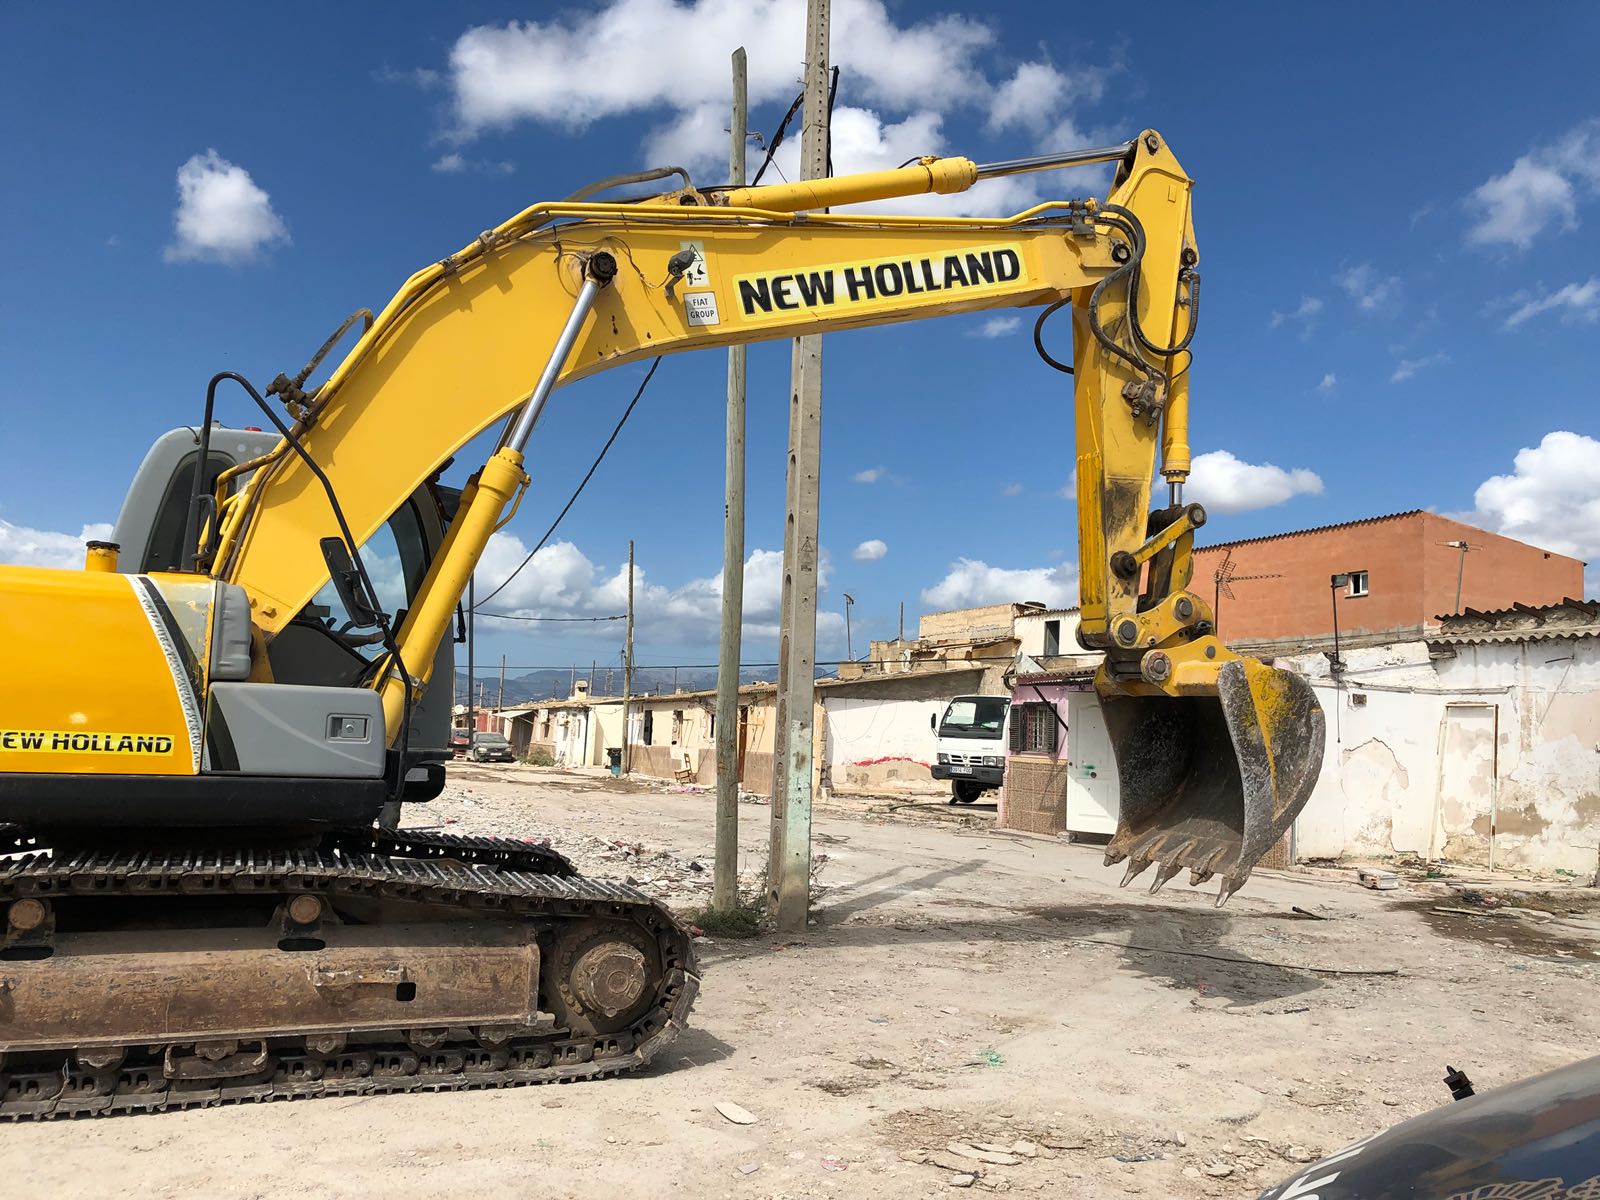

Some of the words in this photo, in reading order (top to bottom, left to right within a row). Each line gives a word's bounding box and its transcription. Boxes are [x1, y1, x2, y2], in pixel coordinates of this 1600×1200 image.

[738, 270, 835, 315] NEW
[844, 248, 1021, 302] HOLLAND
[692, 298, 709, 307] FIAT
[690, 309, 715, 319] GROUP
[0, 731, 45, 750] EW
[52, 733, 172, 754] HOLLAND
